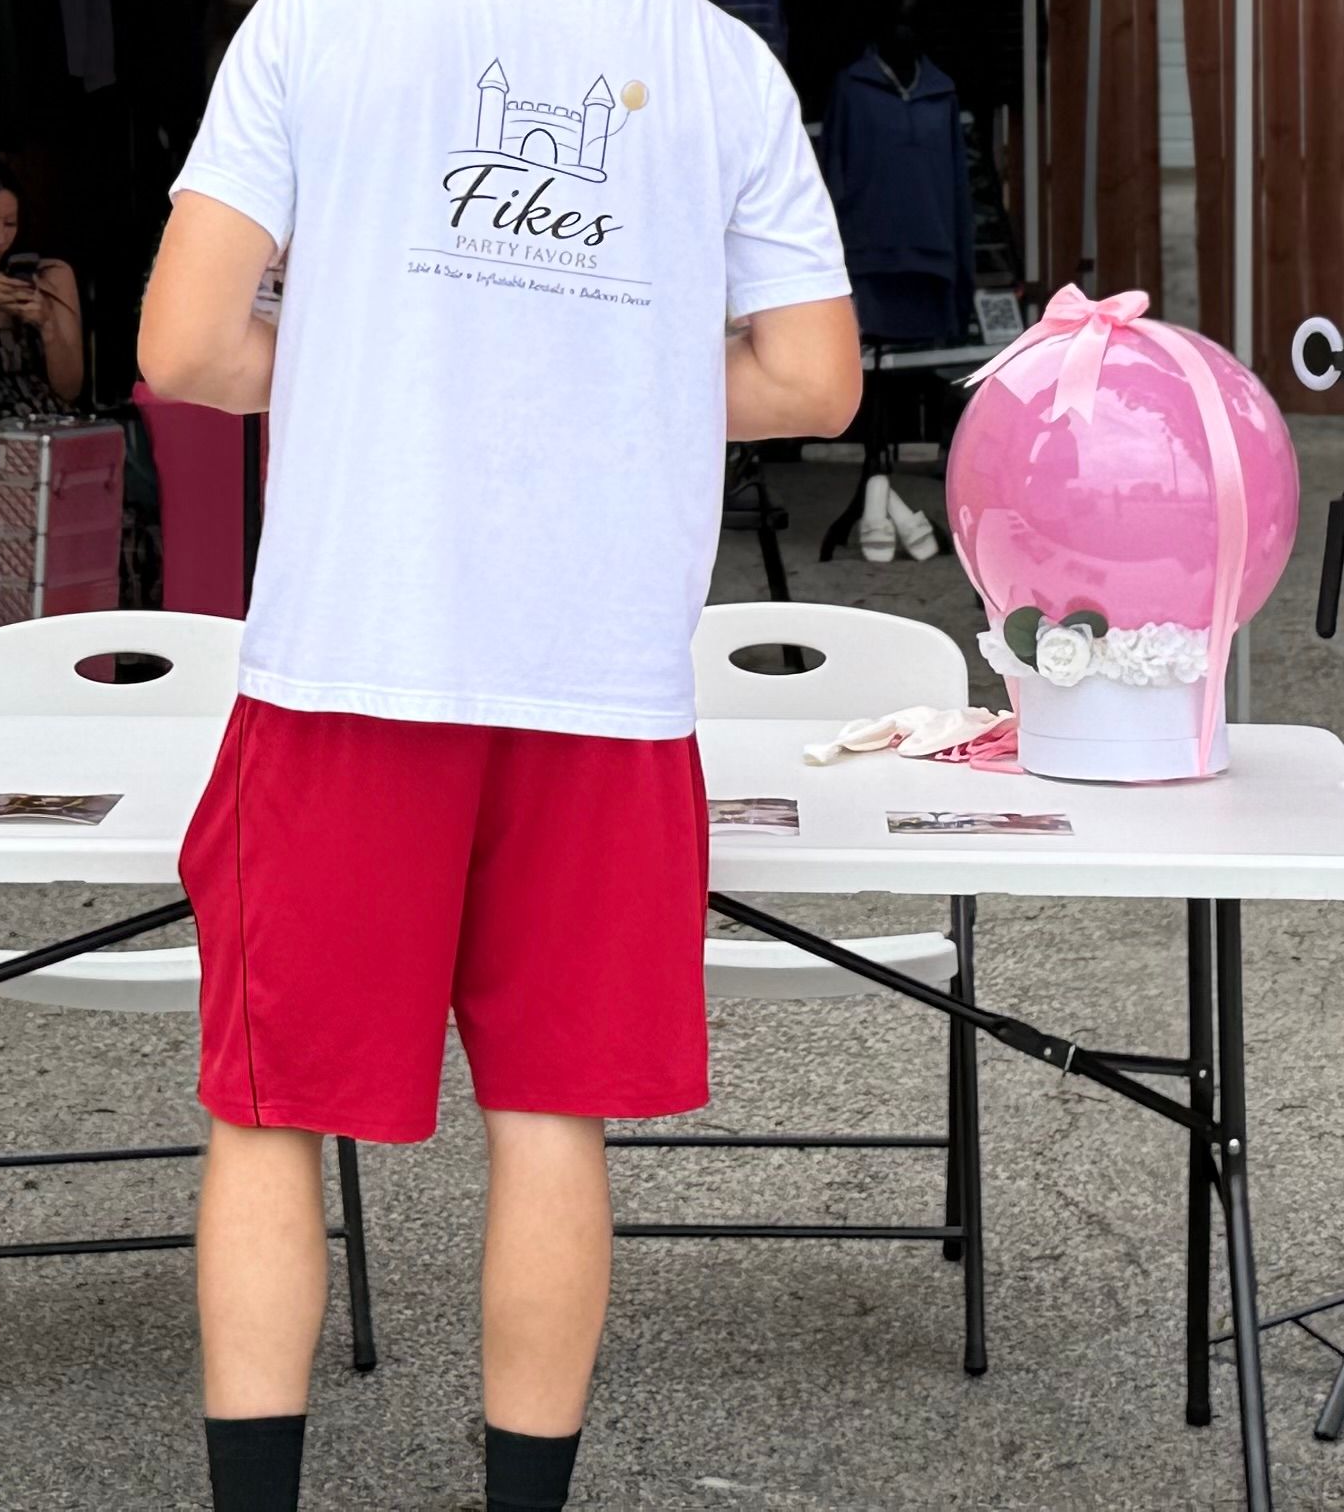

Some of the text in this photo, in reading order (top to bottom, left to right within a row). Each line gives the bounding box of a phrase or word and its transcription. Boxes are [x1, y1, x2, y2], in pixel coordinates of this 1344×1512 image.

[442, 163, 623, 247] Fikes
[455, 234, 598, 270] PARTY FAVORS
